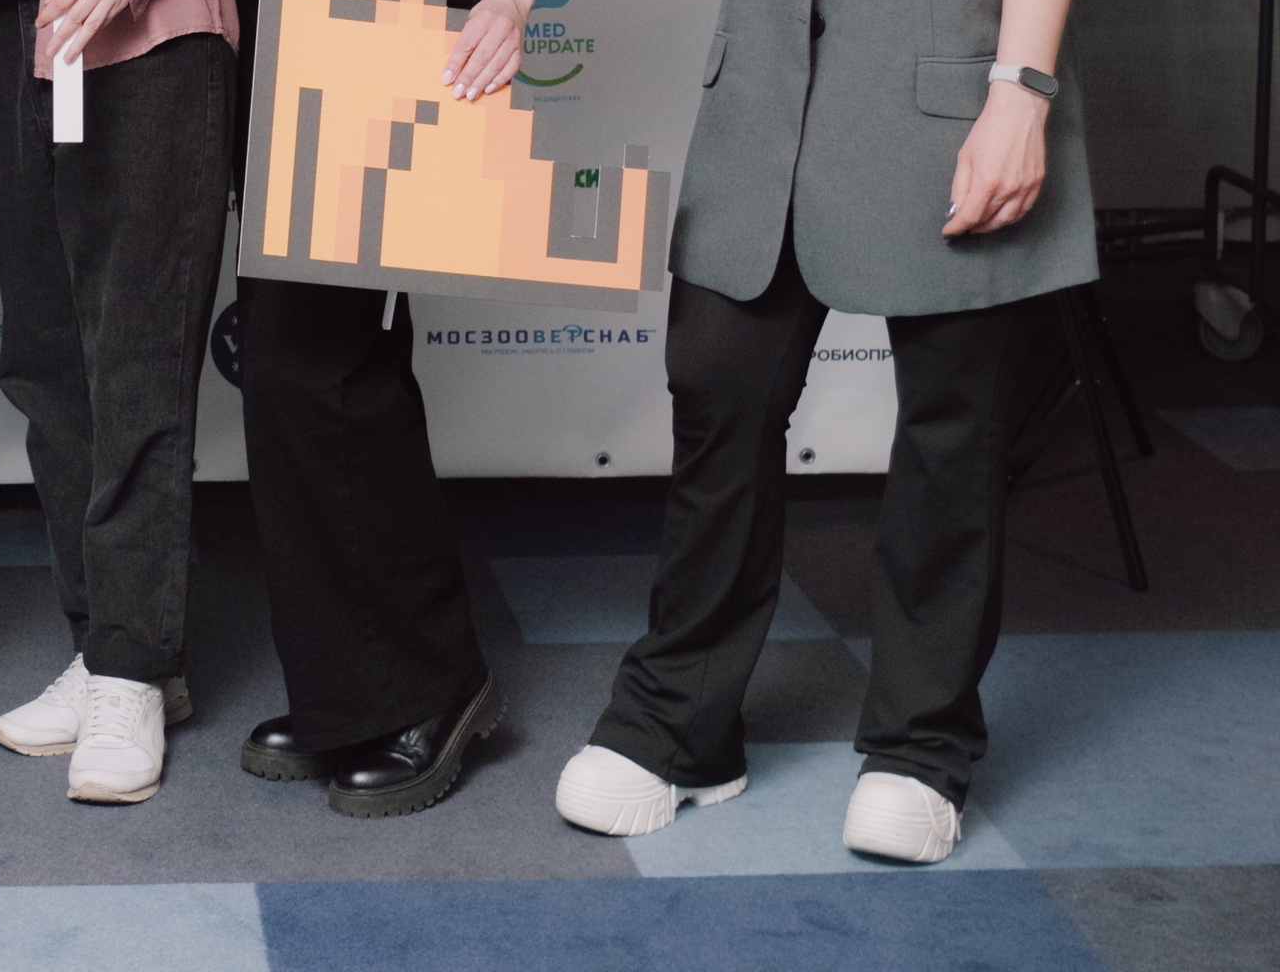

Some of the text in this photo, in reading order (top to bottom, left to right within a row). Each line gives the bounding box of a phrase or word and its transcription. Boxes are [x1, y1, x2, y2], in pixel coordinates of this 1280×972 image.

[524, 23, 566, 38] MED
[523, 39, 595, 54] UPDATE
[426, 324, 657, 345] МОСЗООВЕТСНАБ
